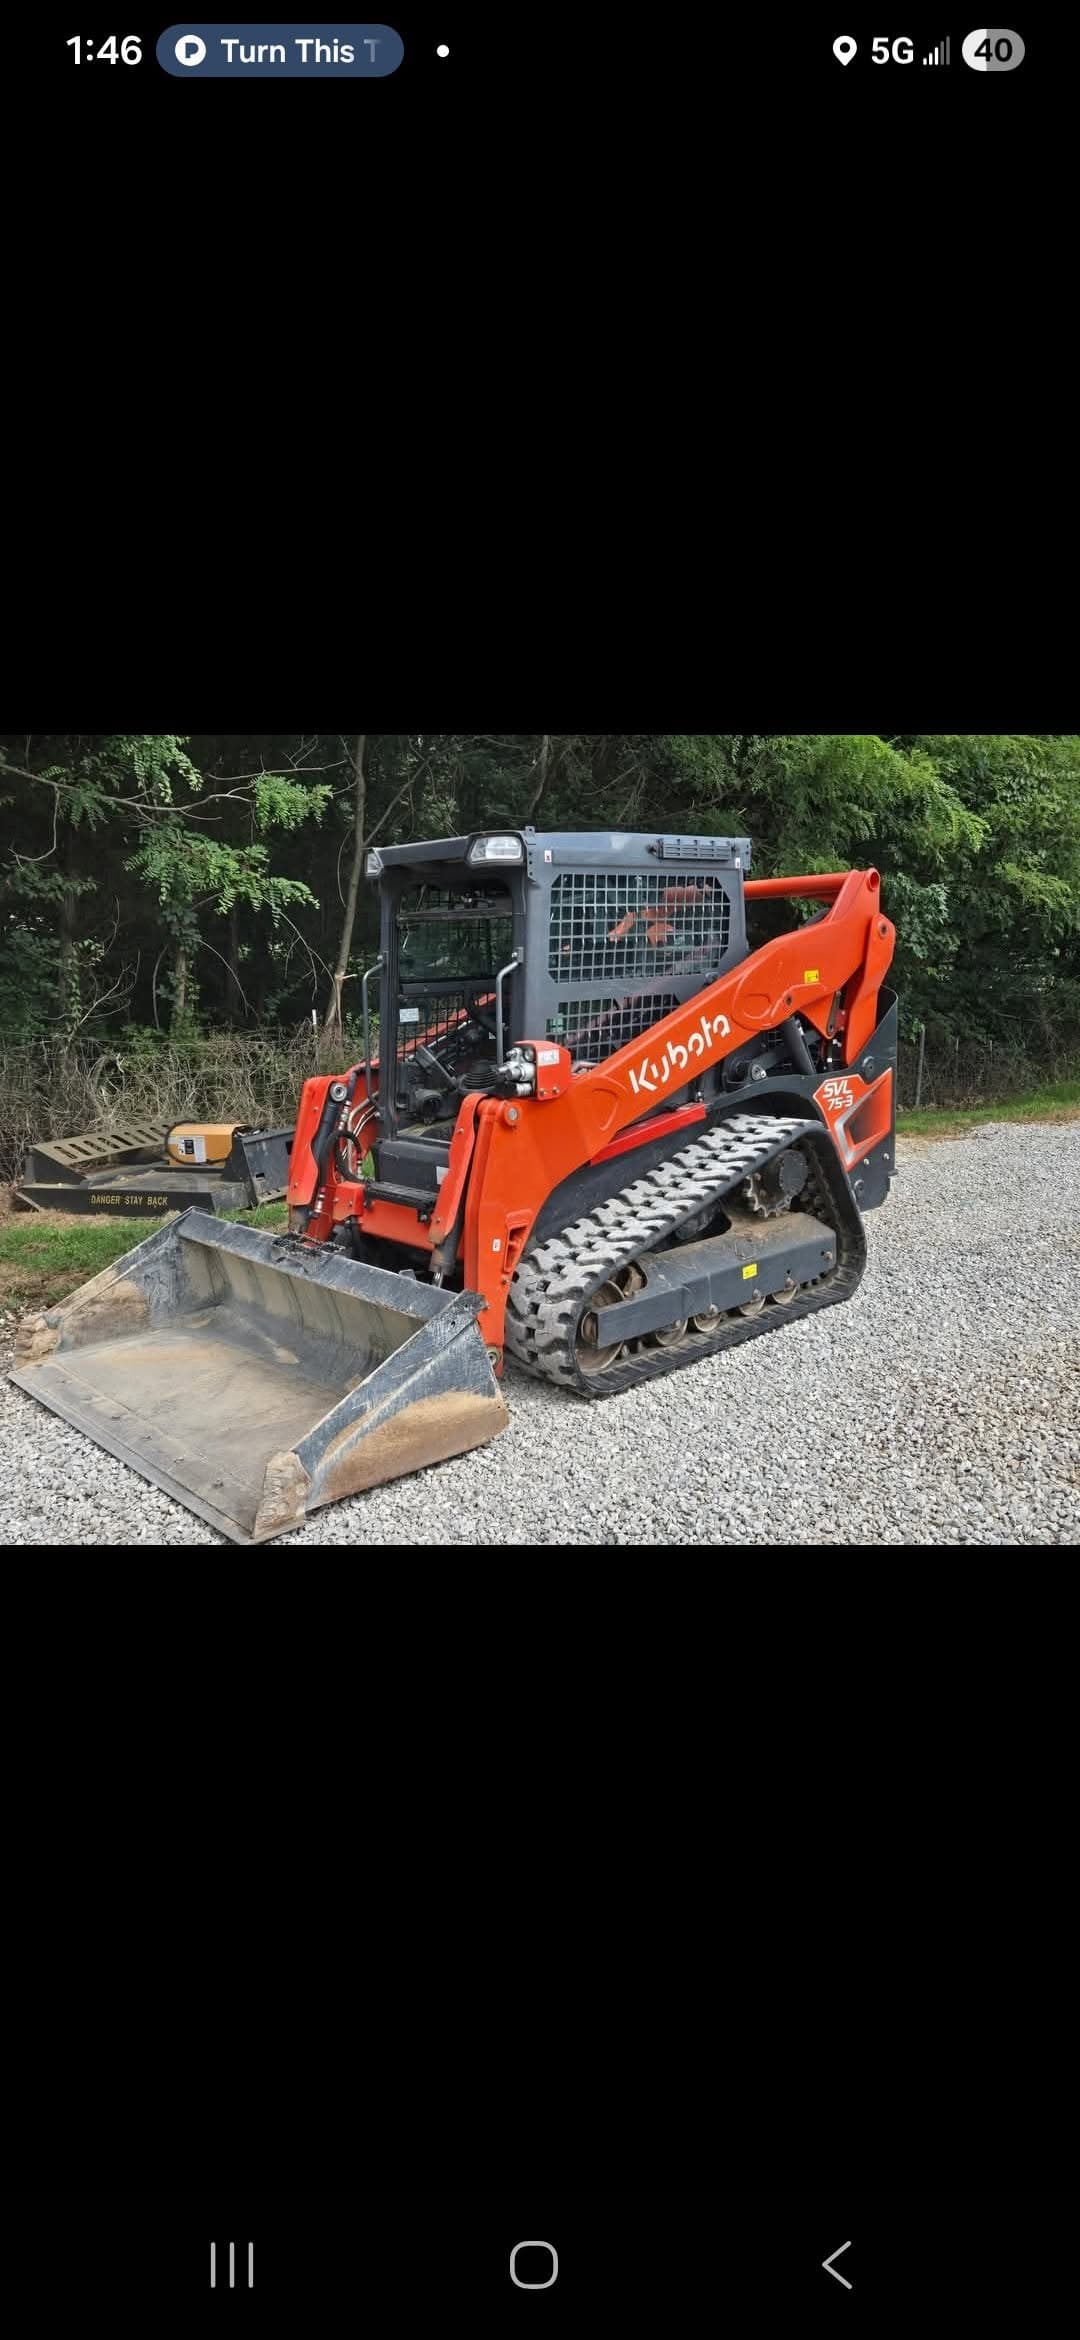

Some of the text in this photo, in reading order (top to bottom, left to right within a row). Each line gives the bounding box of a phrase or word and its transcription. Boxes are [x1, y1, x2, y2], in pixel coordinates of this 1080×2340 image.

[628, 1014, 731, 1094] Kubota
[822, 1082, 852, 1099] SVL
[827, 1097, 853, 1111] 75-3
[90, 1194, 168, 1206] DANGER STAY BACK
